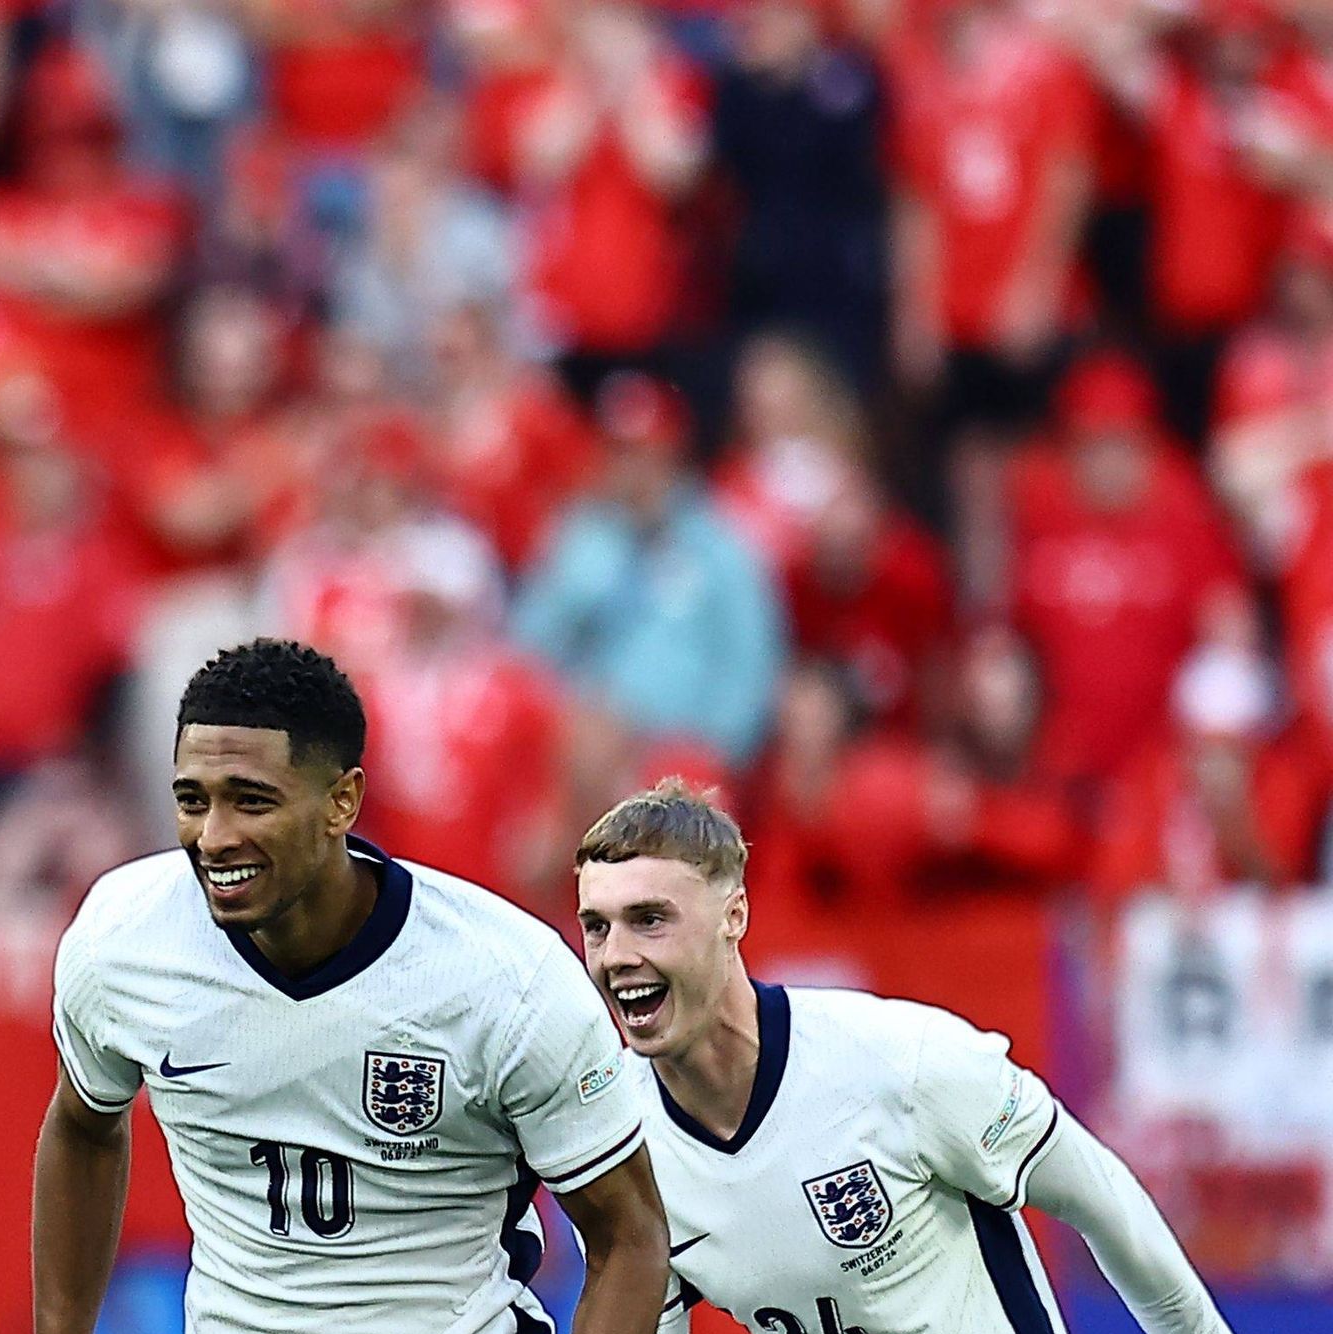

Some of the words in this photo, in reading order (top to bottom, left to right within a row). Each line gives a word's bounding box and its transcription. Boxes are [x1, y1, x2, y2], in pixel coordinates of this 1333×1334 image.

[364, 1137, 439, 1150] SWITZERLAND
[250, 1140, 355, 1240] 10
[840, 1229, 903, 1272] SWITZERLAND
